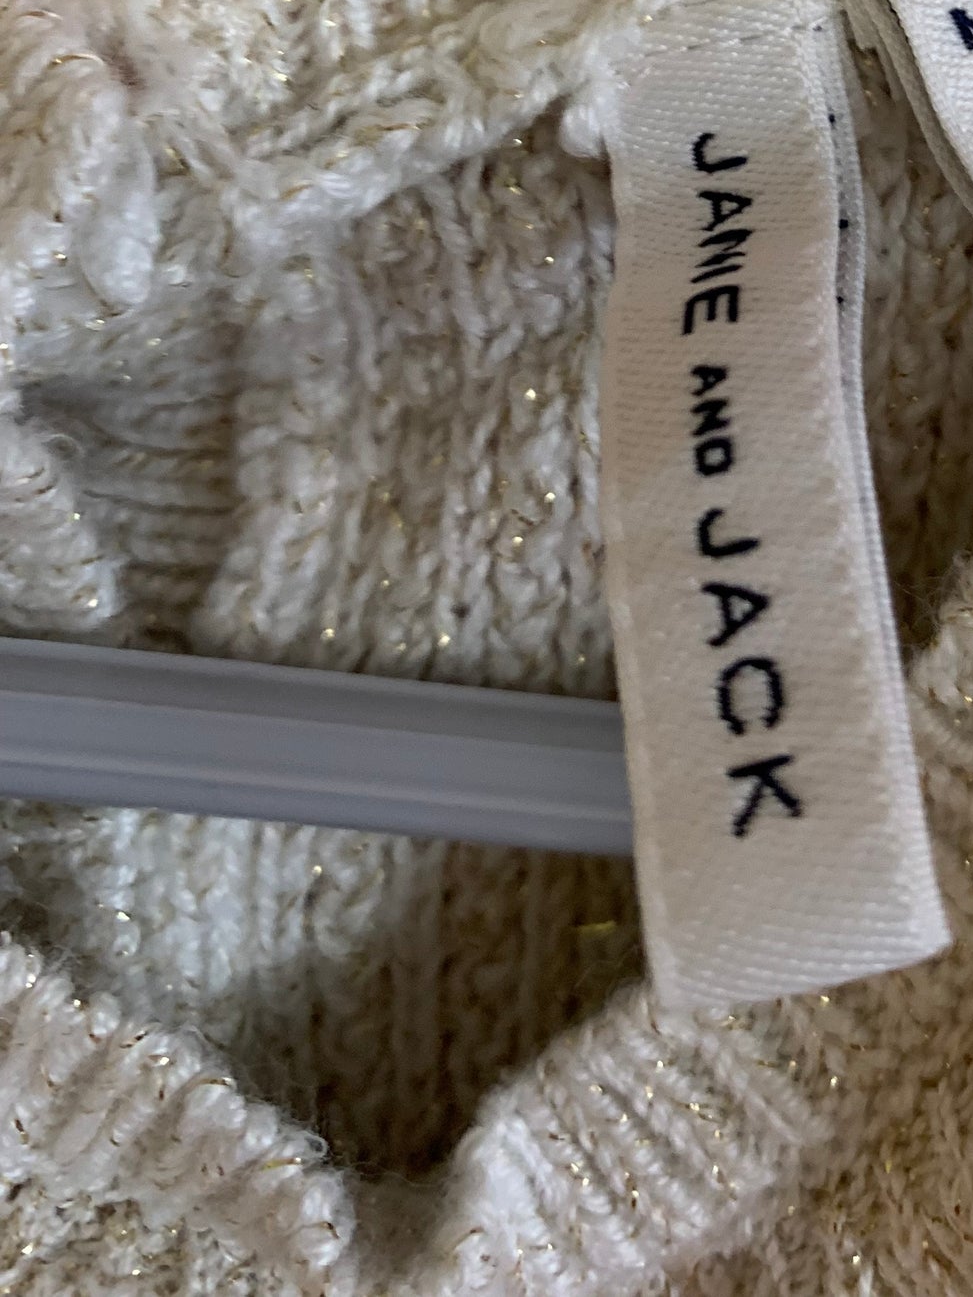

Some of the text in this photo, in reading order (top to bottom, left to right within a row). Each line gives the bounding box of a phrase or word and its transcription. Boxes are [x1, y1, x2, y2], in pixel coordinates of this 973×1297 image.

[681, 132, 804, 839] JANIE AND JACK
